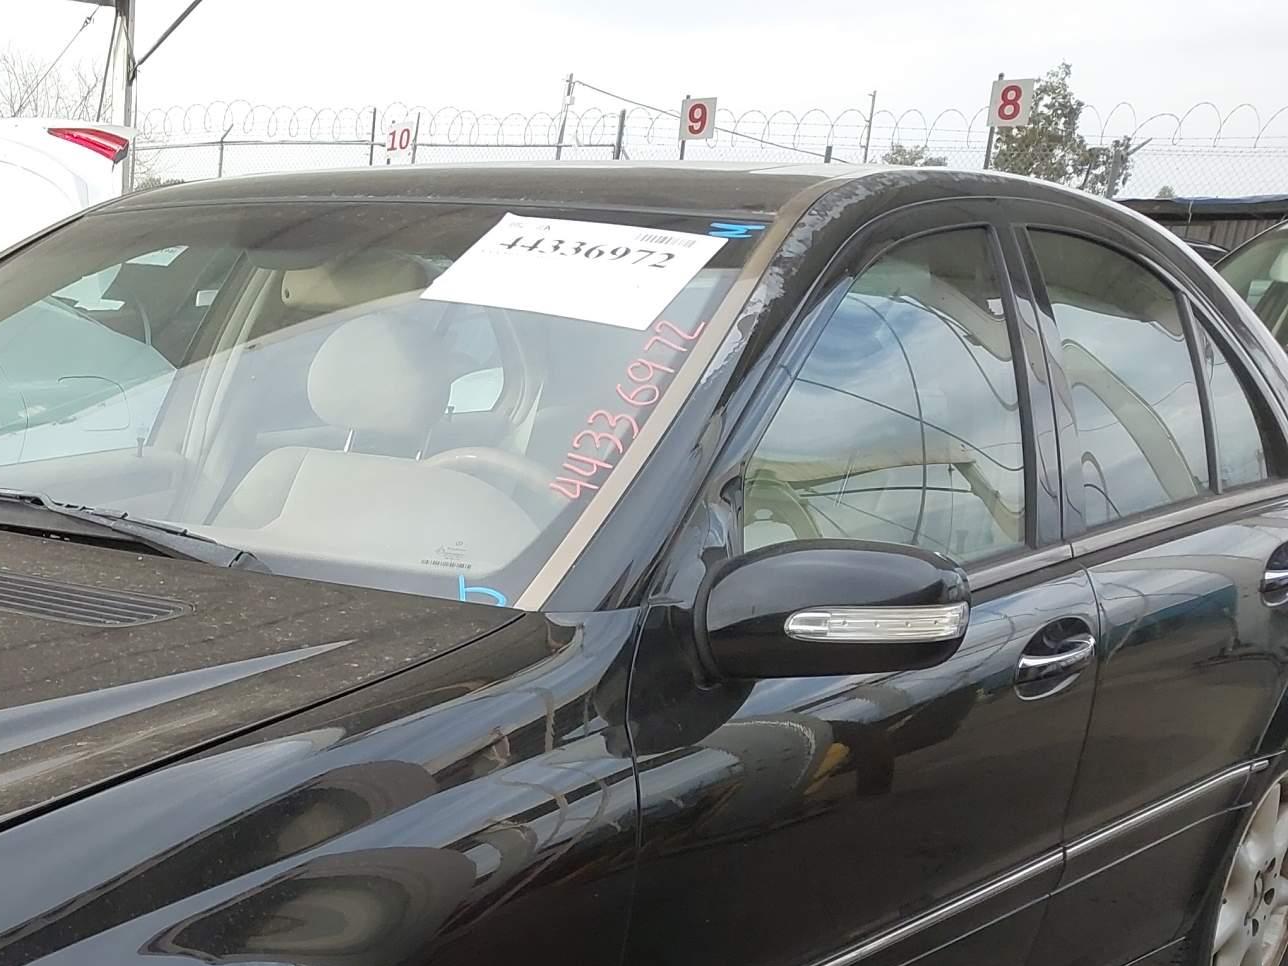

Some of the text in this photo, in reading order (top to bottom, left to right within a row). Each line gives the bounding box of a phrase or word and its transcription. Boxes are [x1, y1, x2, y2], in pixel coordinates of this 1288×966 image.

[688, 103, 707, 134] 9
[998, 85, 1022, 120] 8
[387, 128, 410, 151] 10
[497, 235, 676, 269] 44336972
[549, 320, 705, 499] 44336972
